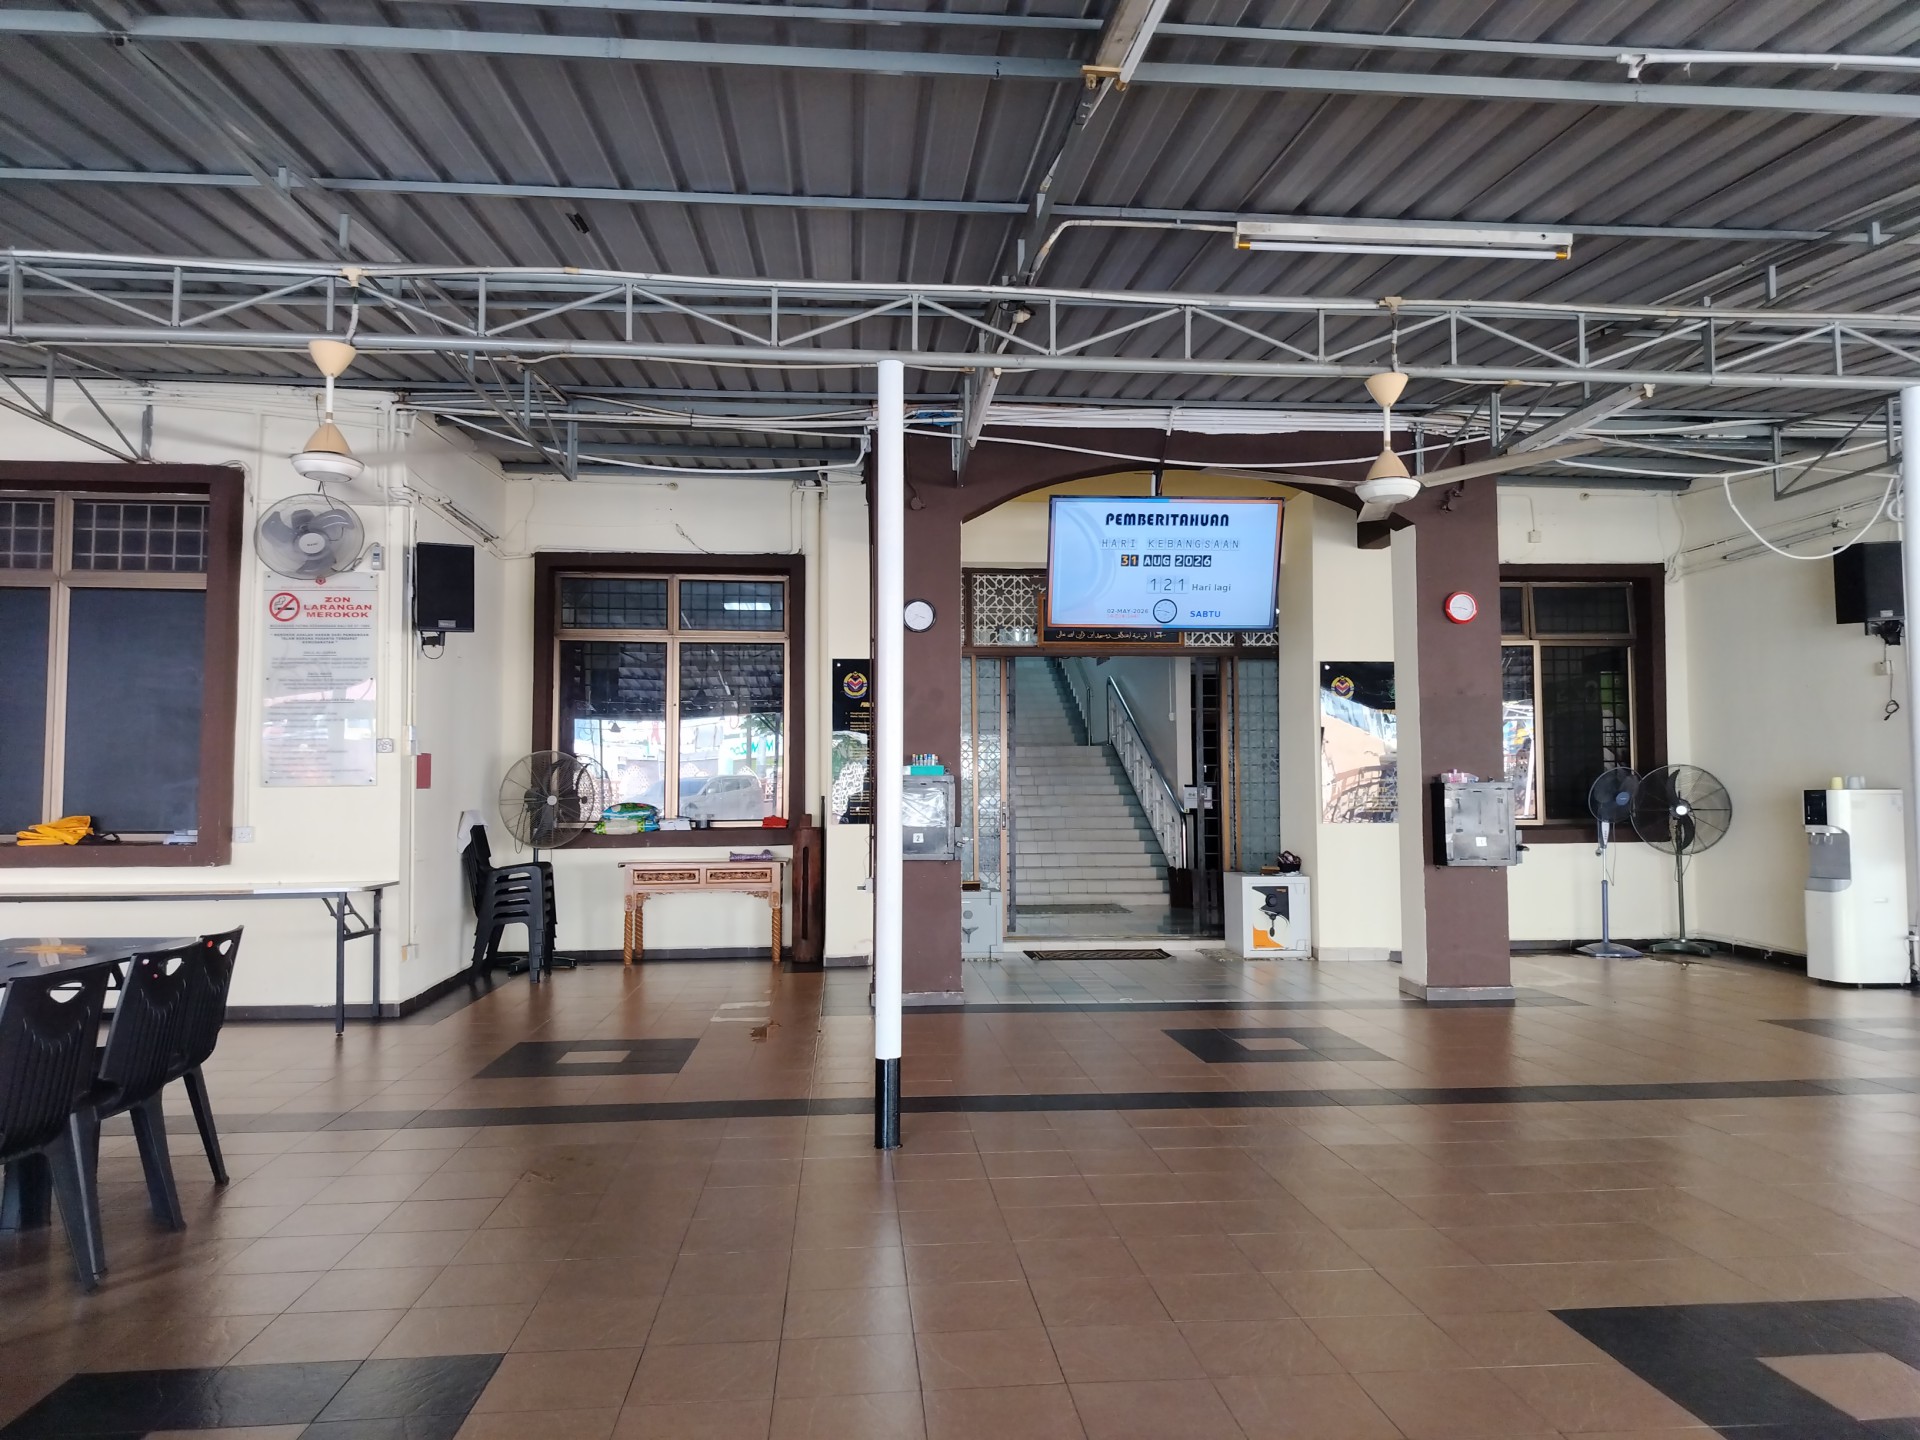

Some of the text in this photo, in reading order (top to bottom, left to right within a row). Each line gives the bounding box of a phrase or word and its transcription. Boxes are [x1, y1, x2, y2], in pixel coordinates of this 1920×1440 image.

[1105, 513, 1229, 527] PEMBERITAHUAN
[1101, 539, 1239, 549] HARI KEBANGSAAN
[1121, 555, 1212, 567] 31 AUG 2026
[1150, 578, 1185, 591] 121
[1214, 584, 1232, 593] lagi
[1190, 610, 1221, 618] SABTU
